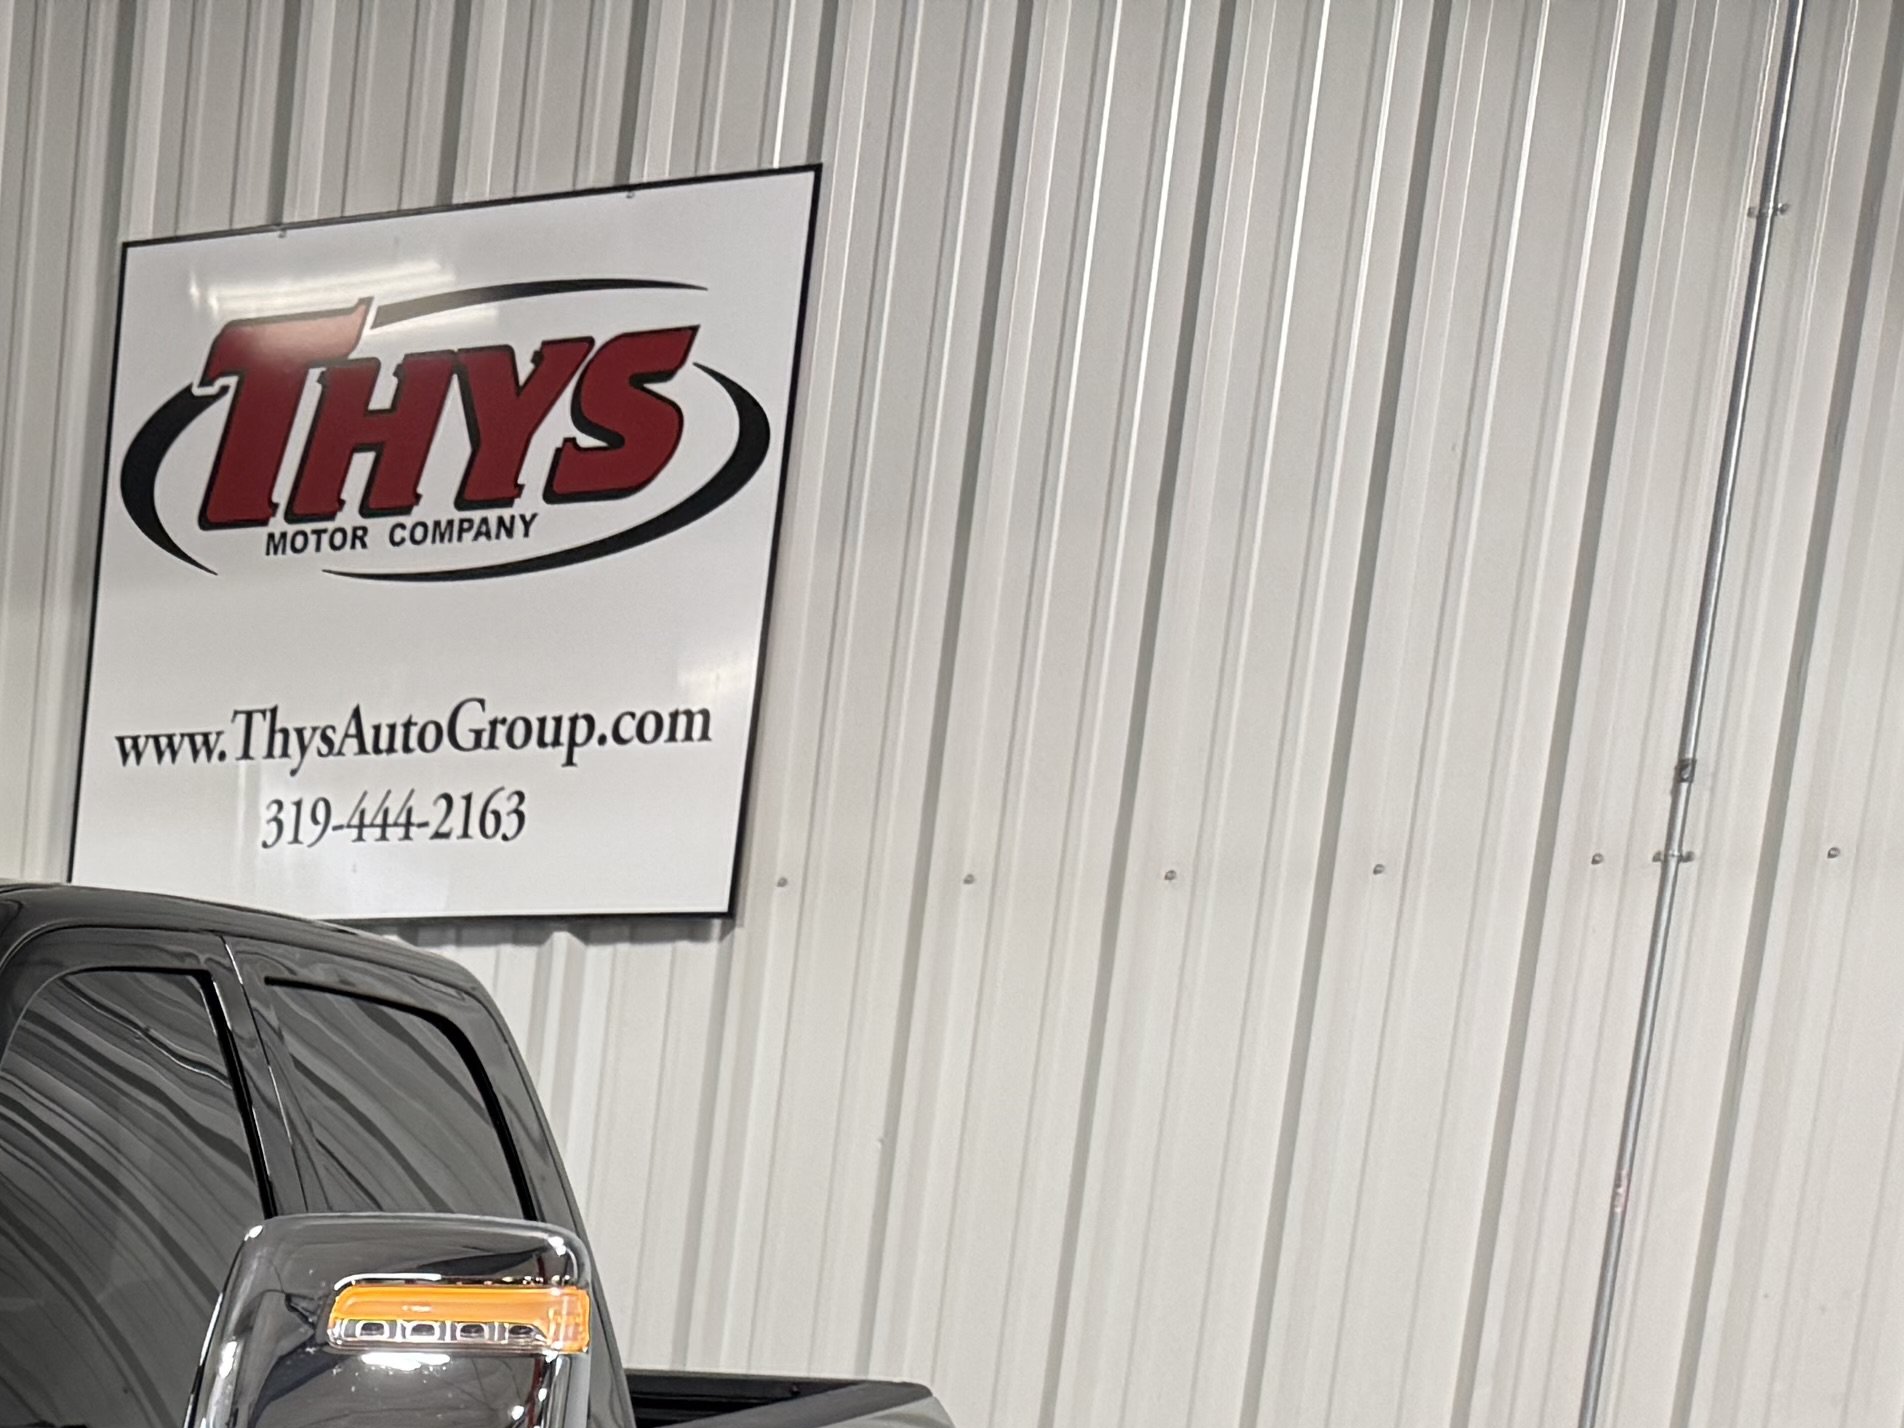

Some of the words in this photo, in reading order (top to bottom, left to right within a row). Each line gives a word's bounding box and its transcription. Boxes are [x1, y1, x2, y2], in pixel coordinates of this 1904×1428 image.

[196, 296, 701, 531] THYS
[264, 524, 370, 557] MOTOR
[388, 513, 540, 549] COMPANY
[114, 698, 713, 777] www.ThysAutoGroup.com
[260, 787, 528, 849] 319-444-2163
